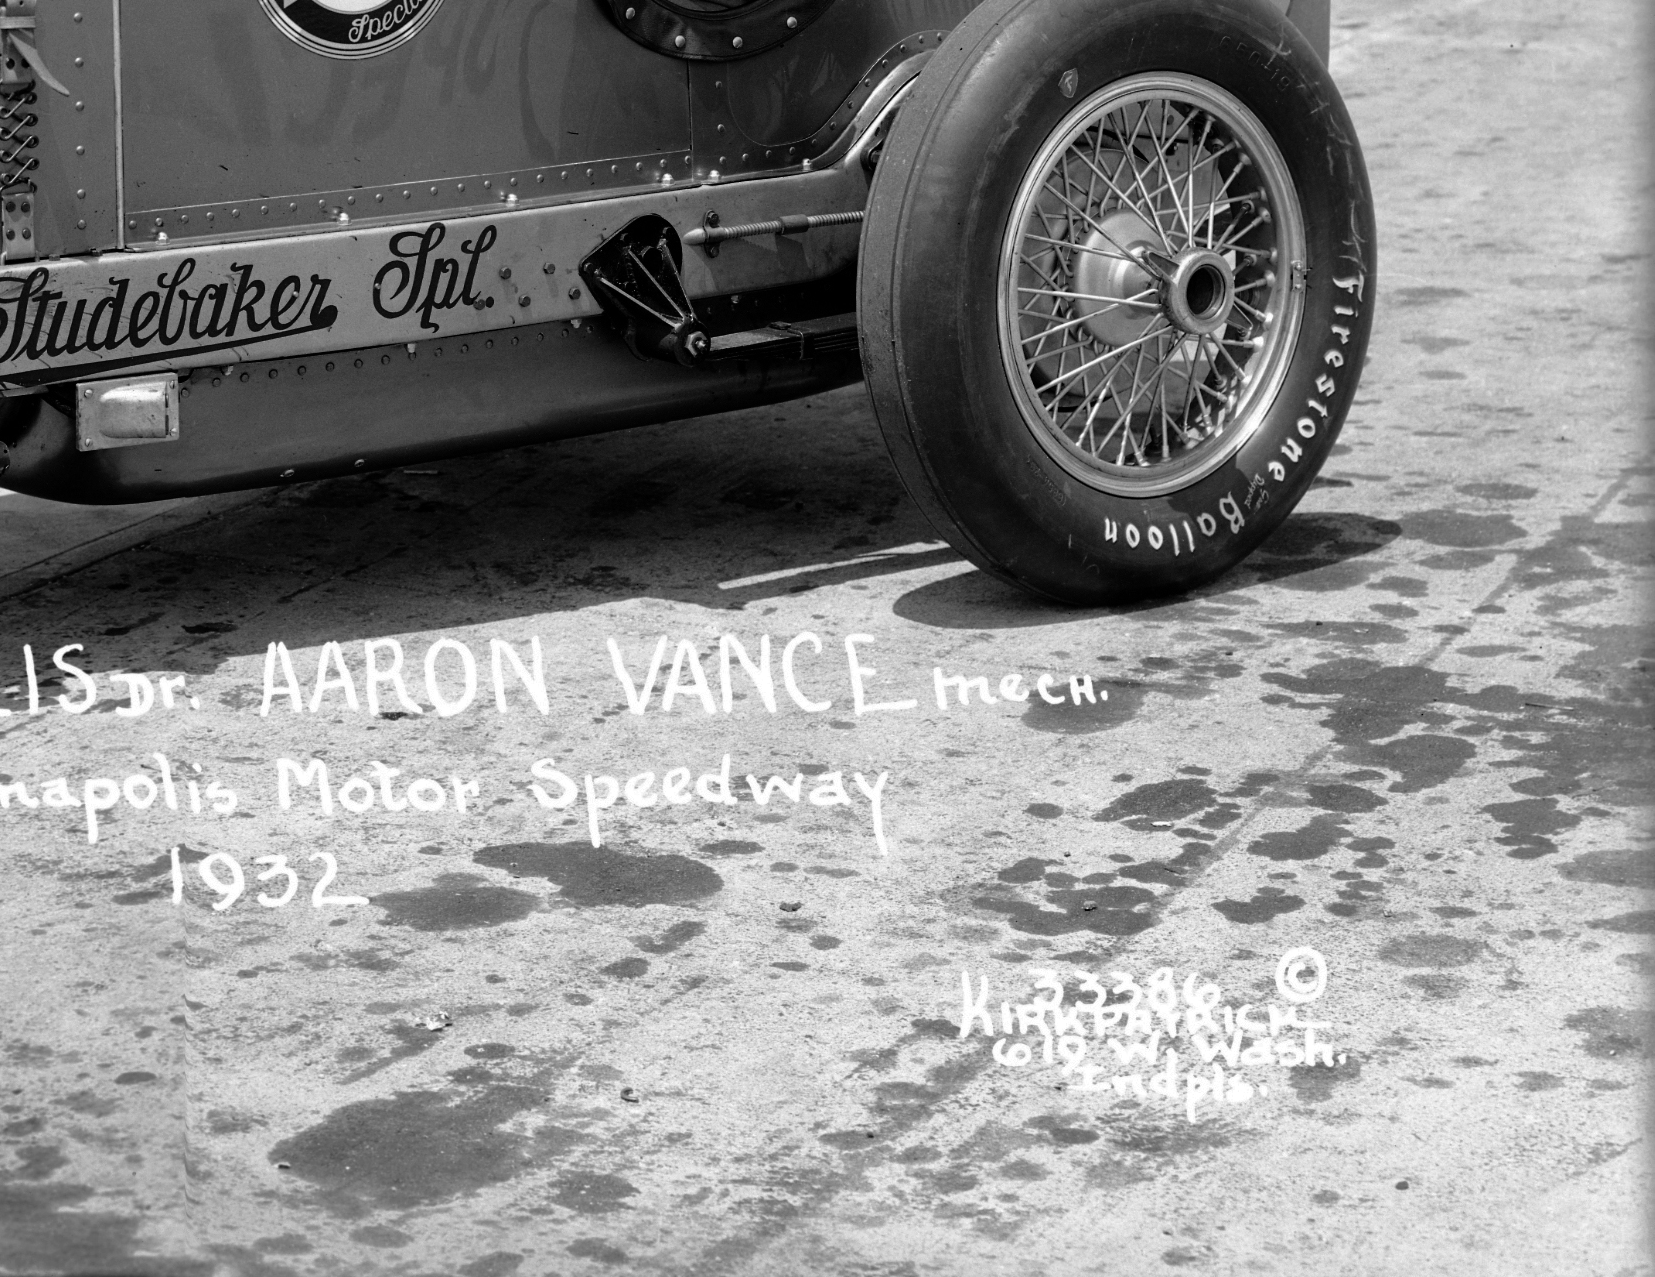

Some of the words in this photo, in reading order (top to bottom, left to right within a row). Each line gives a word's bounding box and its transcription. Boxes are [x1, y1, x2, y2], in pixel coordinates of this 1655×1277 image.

[374, 223, 496, 332] Spl.
[1267, 270, 1364, 481] Firestone
[1104, 491, 1245, 556] Balloon
